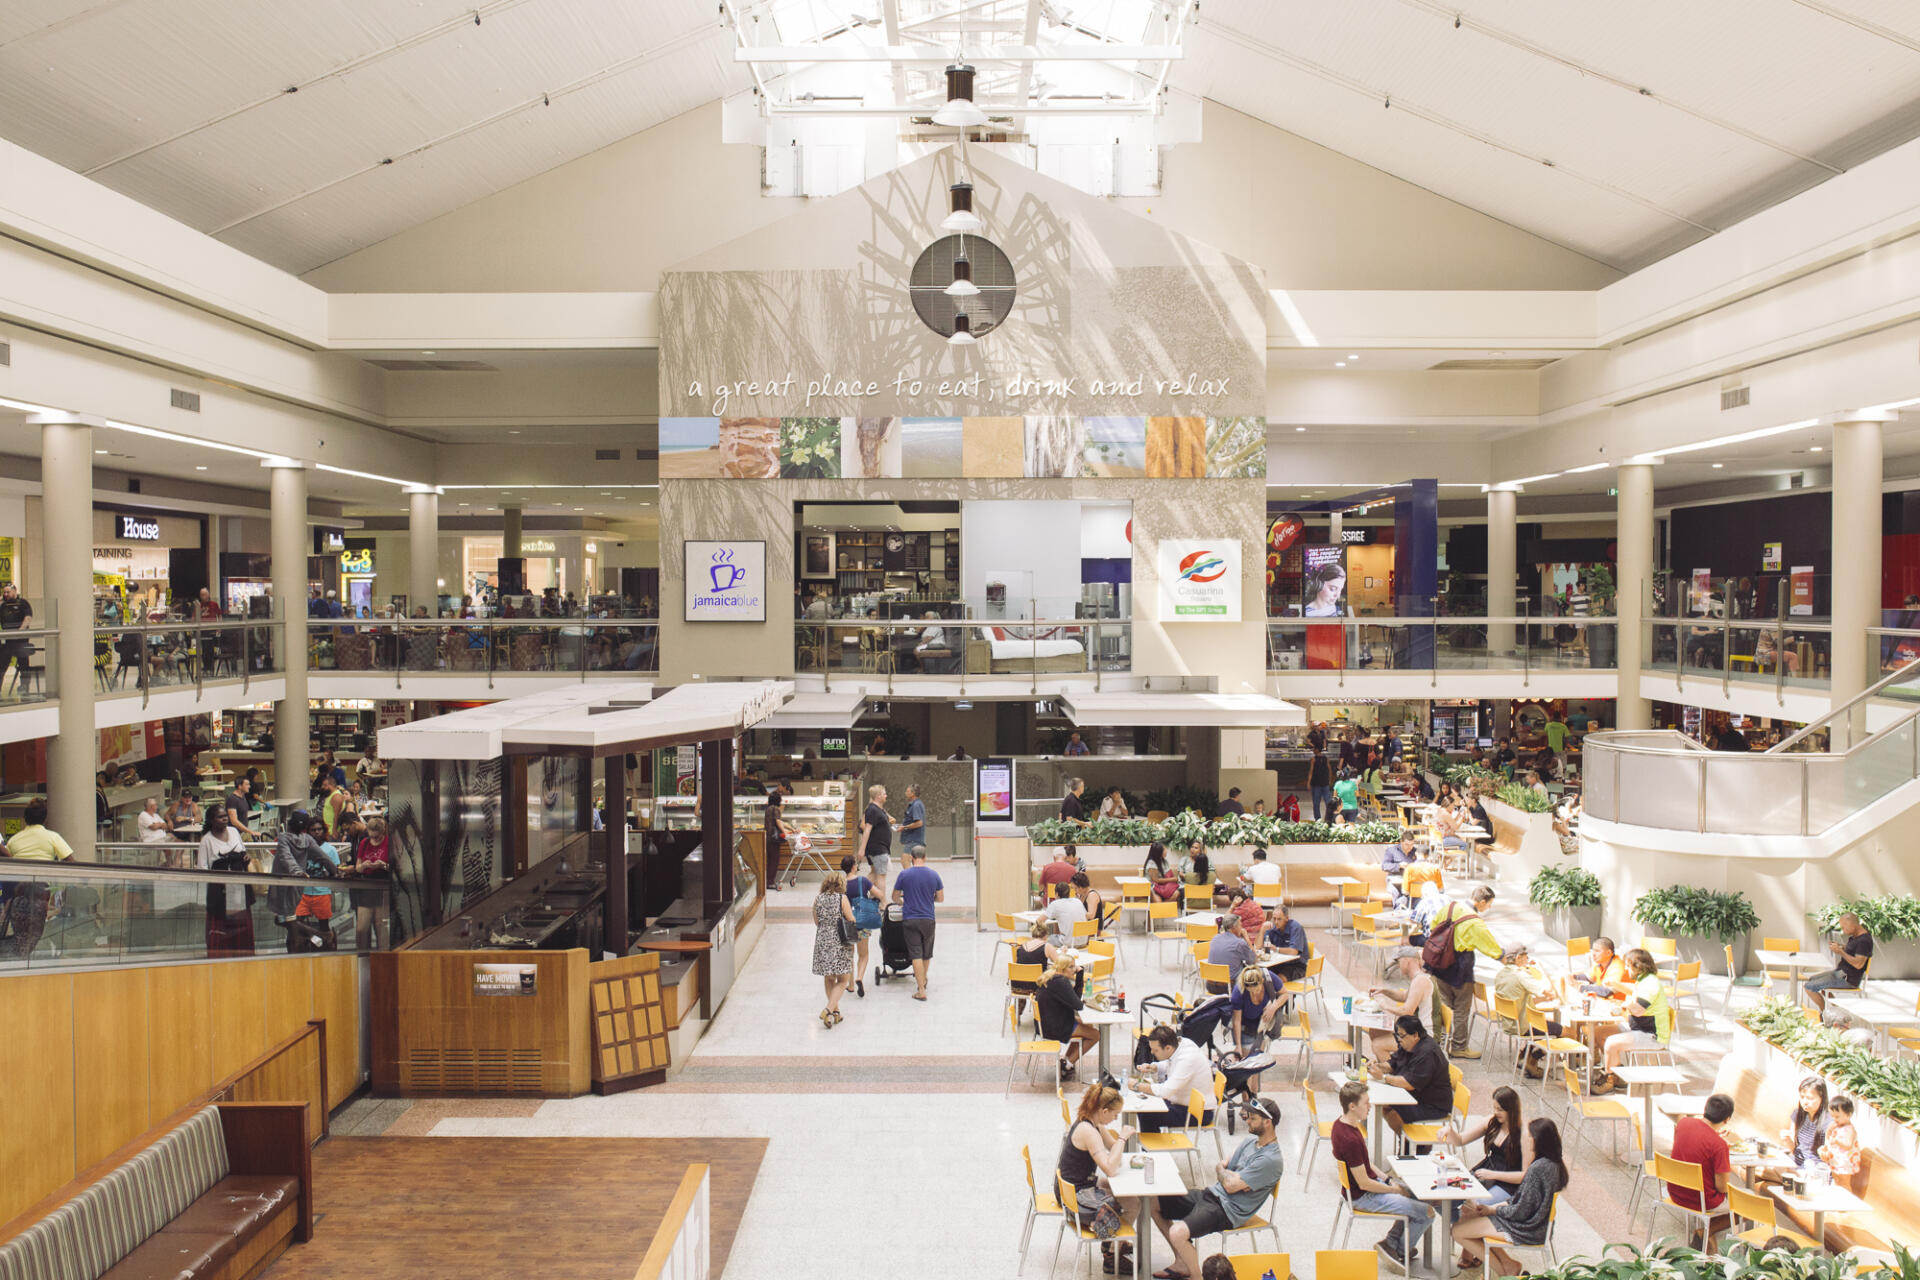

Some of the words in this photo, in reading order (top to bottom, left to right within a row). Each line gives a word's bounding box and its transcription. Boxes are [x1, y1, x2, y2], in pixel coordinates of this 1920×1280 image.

[688, 380, 703, 396] a
[712, 372, 796, 416] great
[806, 373, 880, 407] place
[891, 372, 922, 396] to
[1006, 372, 1077, 398] drink
[1091, 373, 1144, 397] and
[1156, 373, 1230, 397] relax
[123, 516, 159, 540] House
[93, 548, 133, 558] TAINING
[476, 974, 494, 983] HAVE
